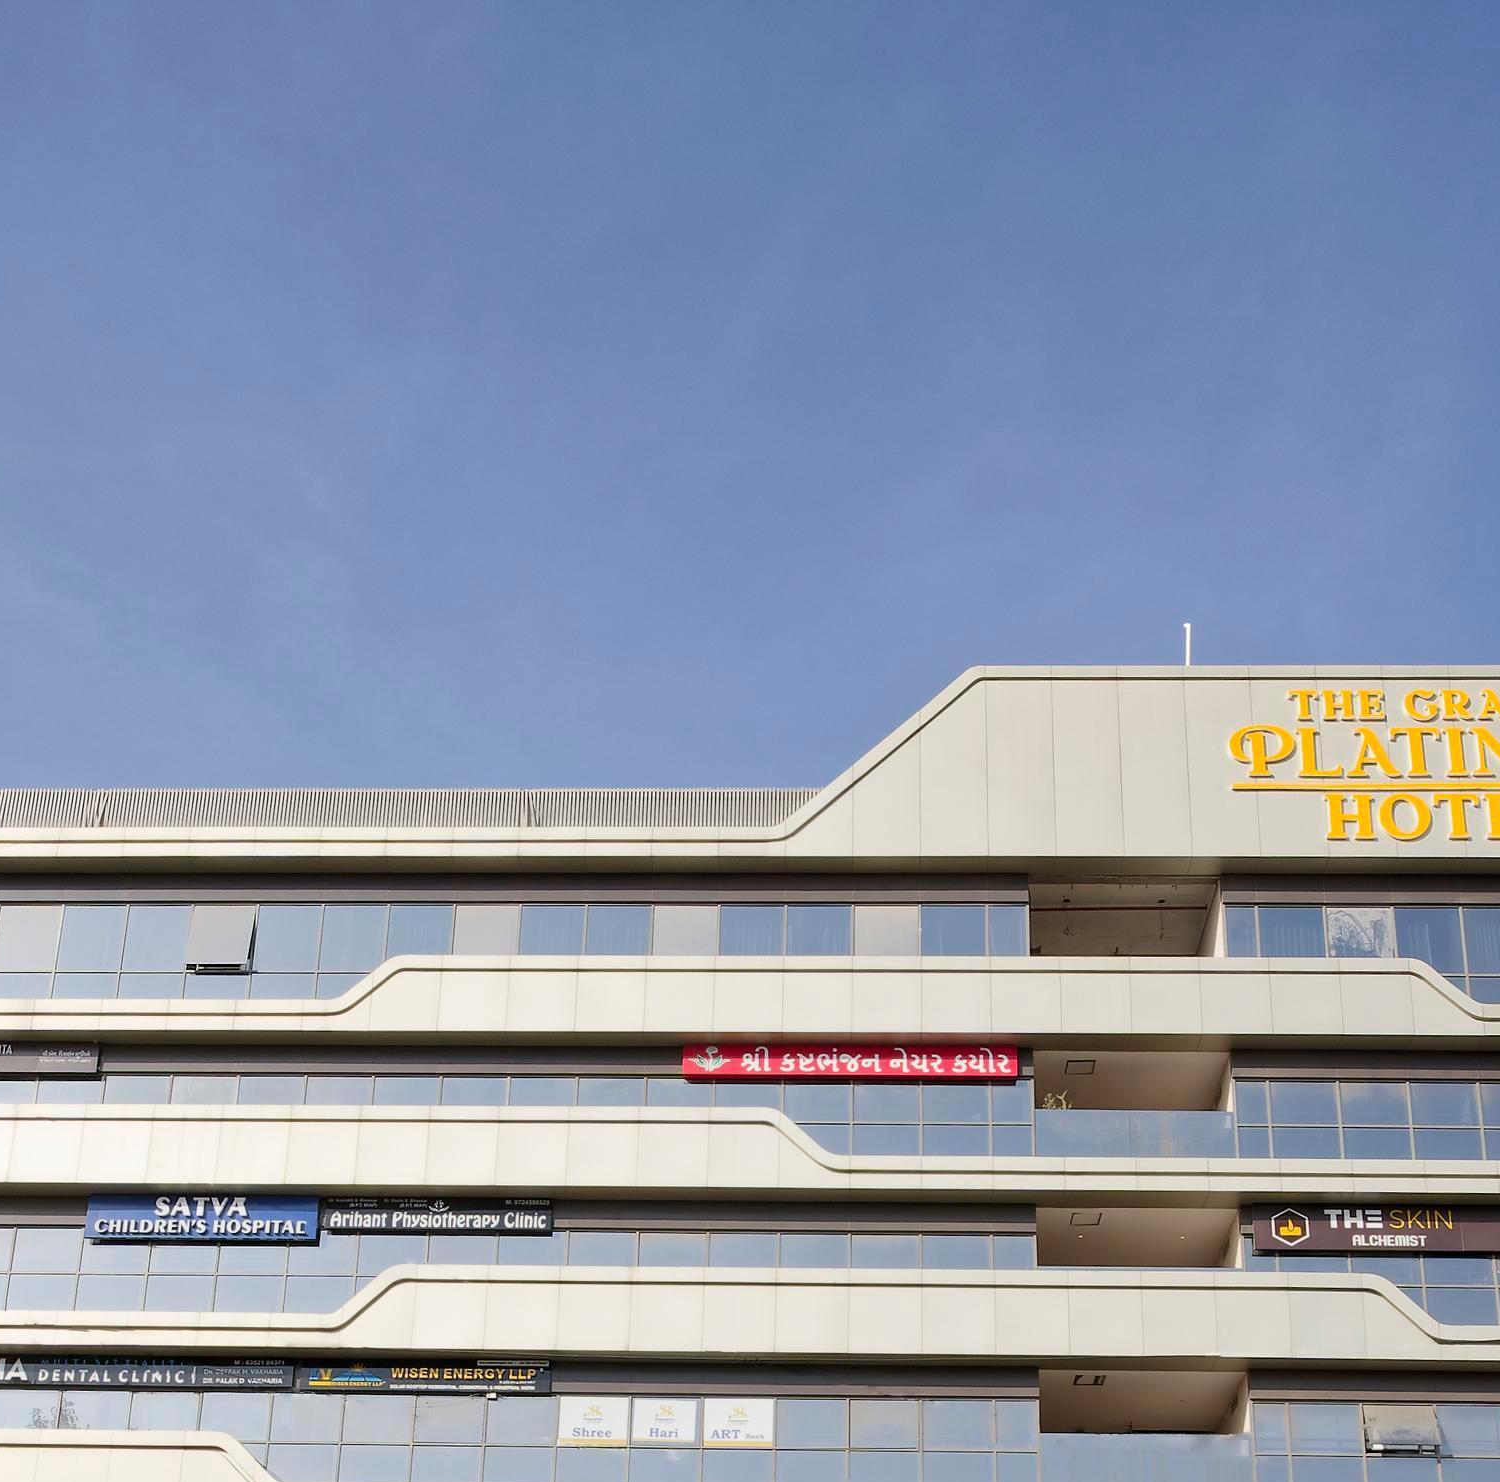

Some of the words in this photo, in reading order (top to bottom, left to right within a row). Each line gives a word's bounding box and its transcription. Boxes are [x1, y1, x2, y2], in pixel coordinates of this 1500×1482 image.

[1289, 689, 1386, 721] THE
[740, 1046, 772, 1073] શ્રી
[889, 1047, 944, 1074] નેચર
[94, 1219, 207, 1235] CHILDREN'S
[212, 1219, 308, 1235] HOSPITAL
[330, 1211, 387, 1228] Arihant
[391, 1211, 500, 1229] Physiotherapy
[504, 1212, 547, 1229] Clinic
[1324, 1209, 1383, 1229] THE
[1388, 1210, 1454, 1230] SKIN
[1352, 1234, 1427, 1247] ALCHEMIST
[37, 1368, 112, 1384] DENTAL
[118, 1368, 185, 1384] CLINIC
[390, 1368, 439, 1379] WISEN
[443, 1368, 505, 1379] ENERGY
[508, 1368, 537, 1379] LLP
[572, 1427, 612, 1438] Shree
[648, 1427, 679, 1438] Hari
[710, 1429, 741, 1440] ART
